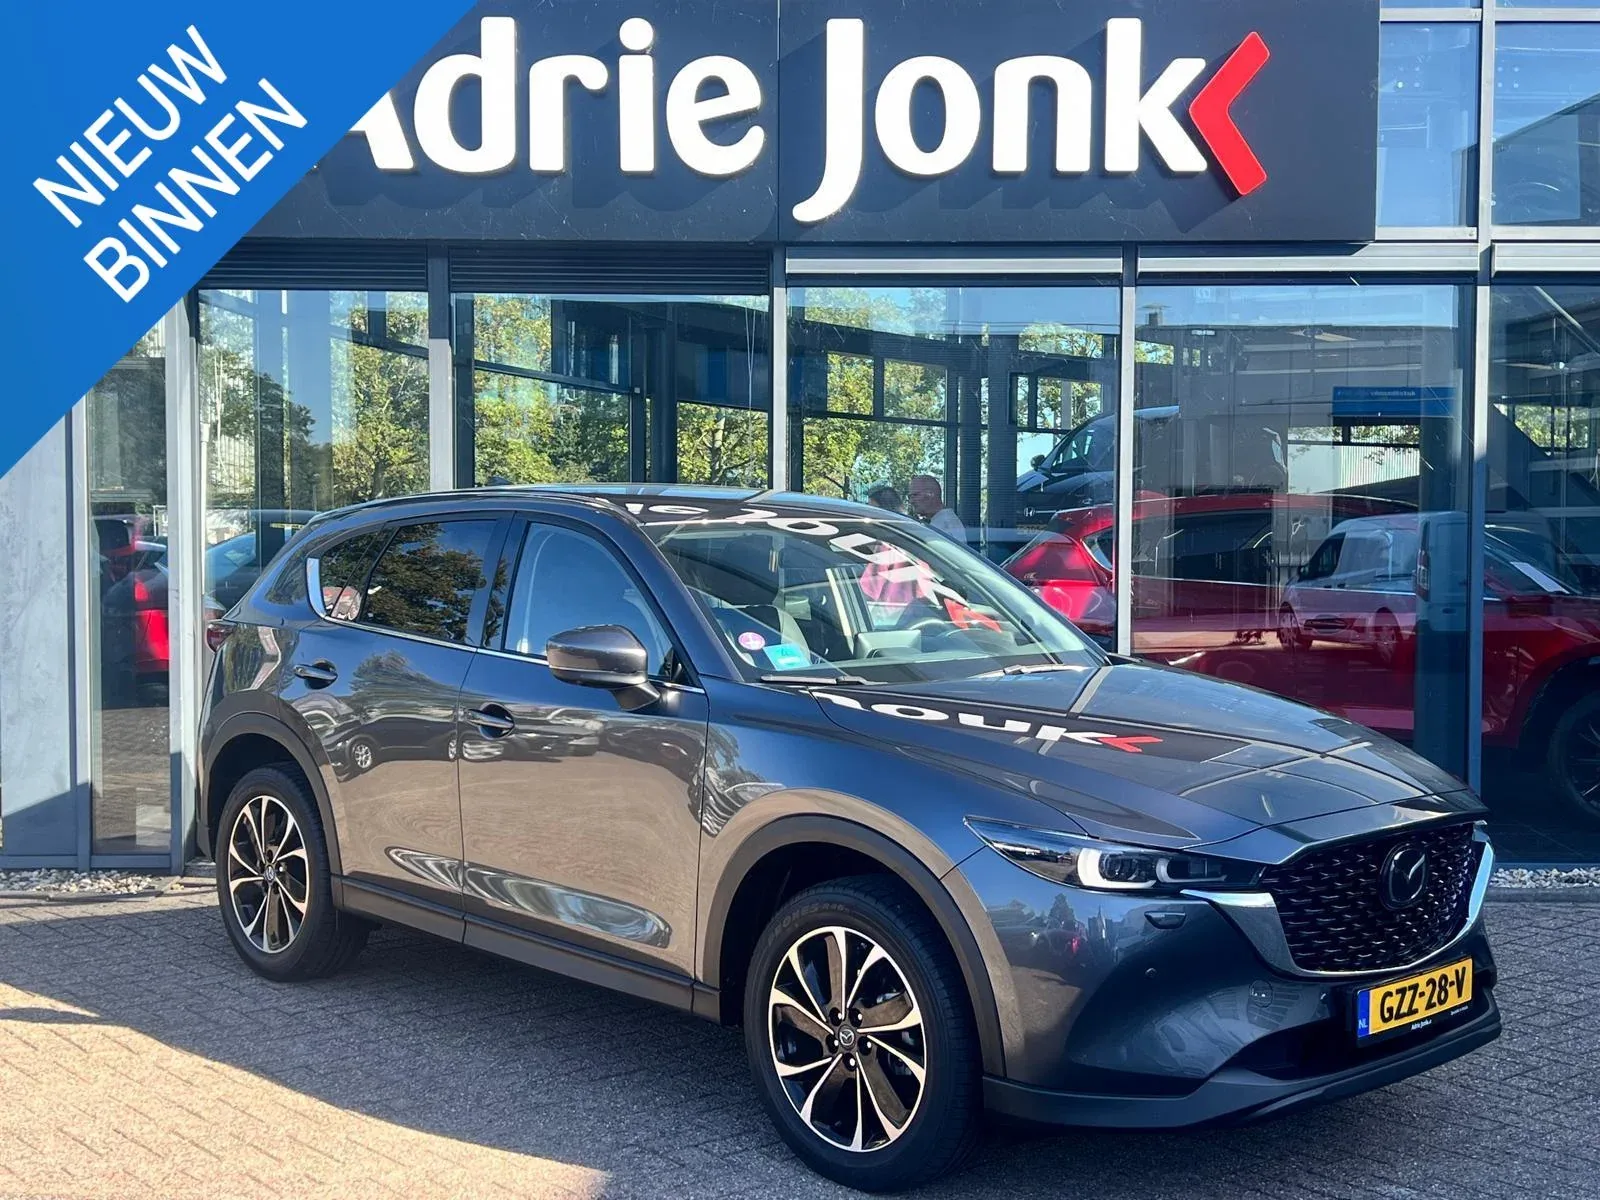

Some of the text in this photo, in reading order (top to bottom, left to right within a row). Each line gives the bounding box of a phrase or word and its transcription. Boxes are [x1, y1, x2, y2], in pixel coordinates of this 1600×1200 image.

[793, 18, 1208, 222] Jonk
[1358, 1018, 1369, 1030] NL
[1379, 966, 1466, 1024] GZZ-28-V
